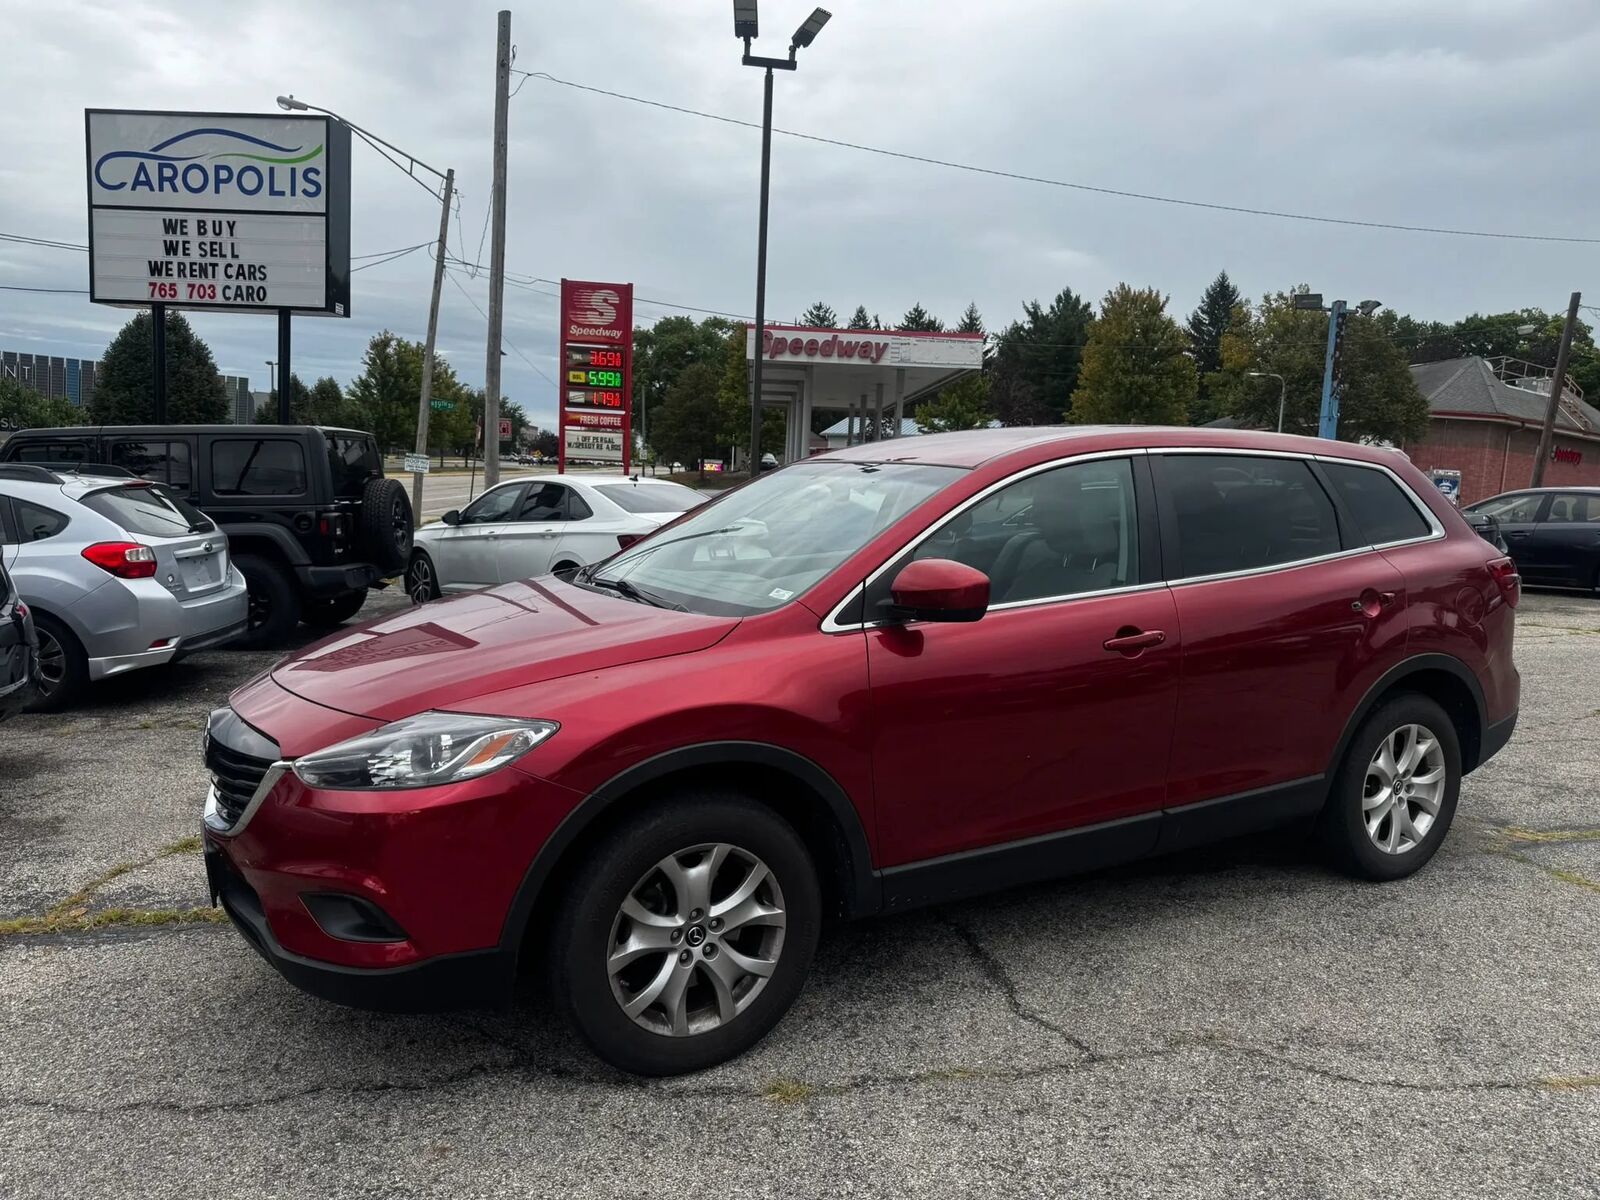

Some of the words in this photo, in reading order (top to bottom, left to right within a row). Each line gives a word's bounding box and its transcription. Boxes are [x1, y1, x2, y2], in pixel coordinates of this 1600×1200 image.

[95, 151, 322, 198] CAROPOLIS
[162, 218, 188, 236] WE
[197, 220, 236, 237] BUY
[163, 240, 190, 257] WE
[198, 241, 240, 259] SELL
[148, 260, 174, 277] WE
[177, 262, 219, 279] RENT
[224, 263, 267, 281] CARS
[148, 282, 178, 299] 765
[187, 283, 217, 300] 703
[222, 285, 267, 301] CARO
[569, 325, 623, 339] Speedway
[761, 330, 889, 363] Speedway
[580, 415, 599, 425] FRESH
[600, 416, 622, 426] COFFEE
